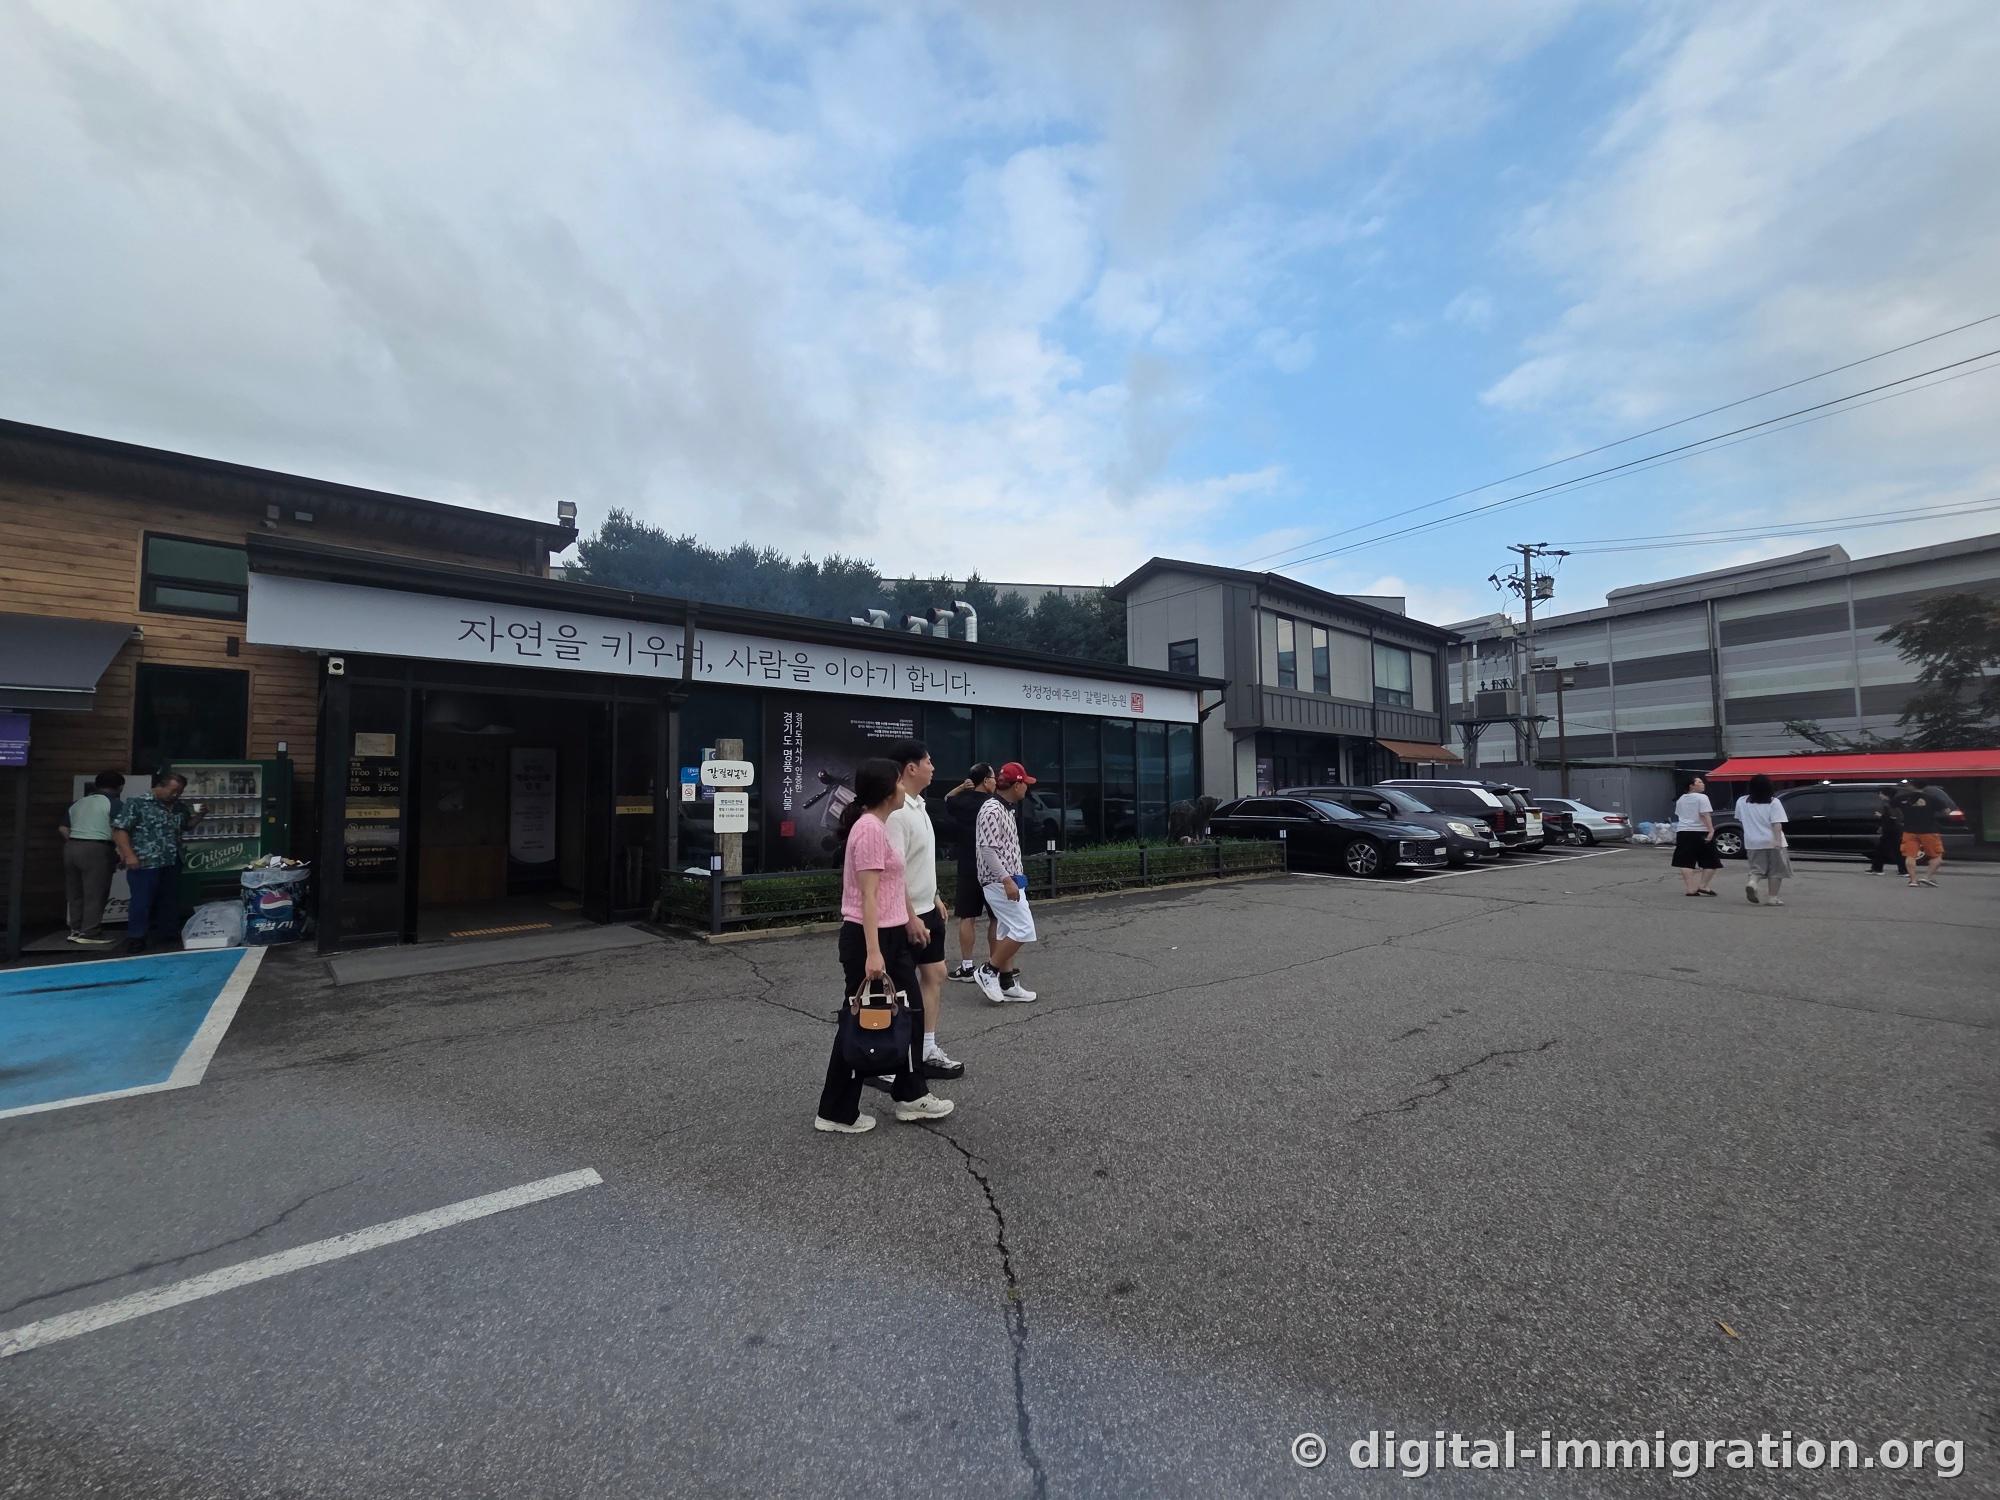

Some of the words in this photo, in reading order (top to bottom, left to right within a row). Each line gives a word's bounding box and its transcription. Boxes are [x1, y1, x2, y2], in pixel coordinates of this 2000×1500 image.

[457, 615, 588, 661] 자연을
[725, 645, 816, 683] 사람을
[825, 656, 896, 691] 이야기
[906, 665, 976, 697] 합니다.
[1084, 690, 1127, 708] 갈릴리농원
[782, 711, 793, 746] 경기도
[794, 712, 803, 765] 경기도지사가
[782, 749, 793, 773] 명품
[782, 775, 793, 811] 수산물
[184, 842, 244, 869] Chilsung
